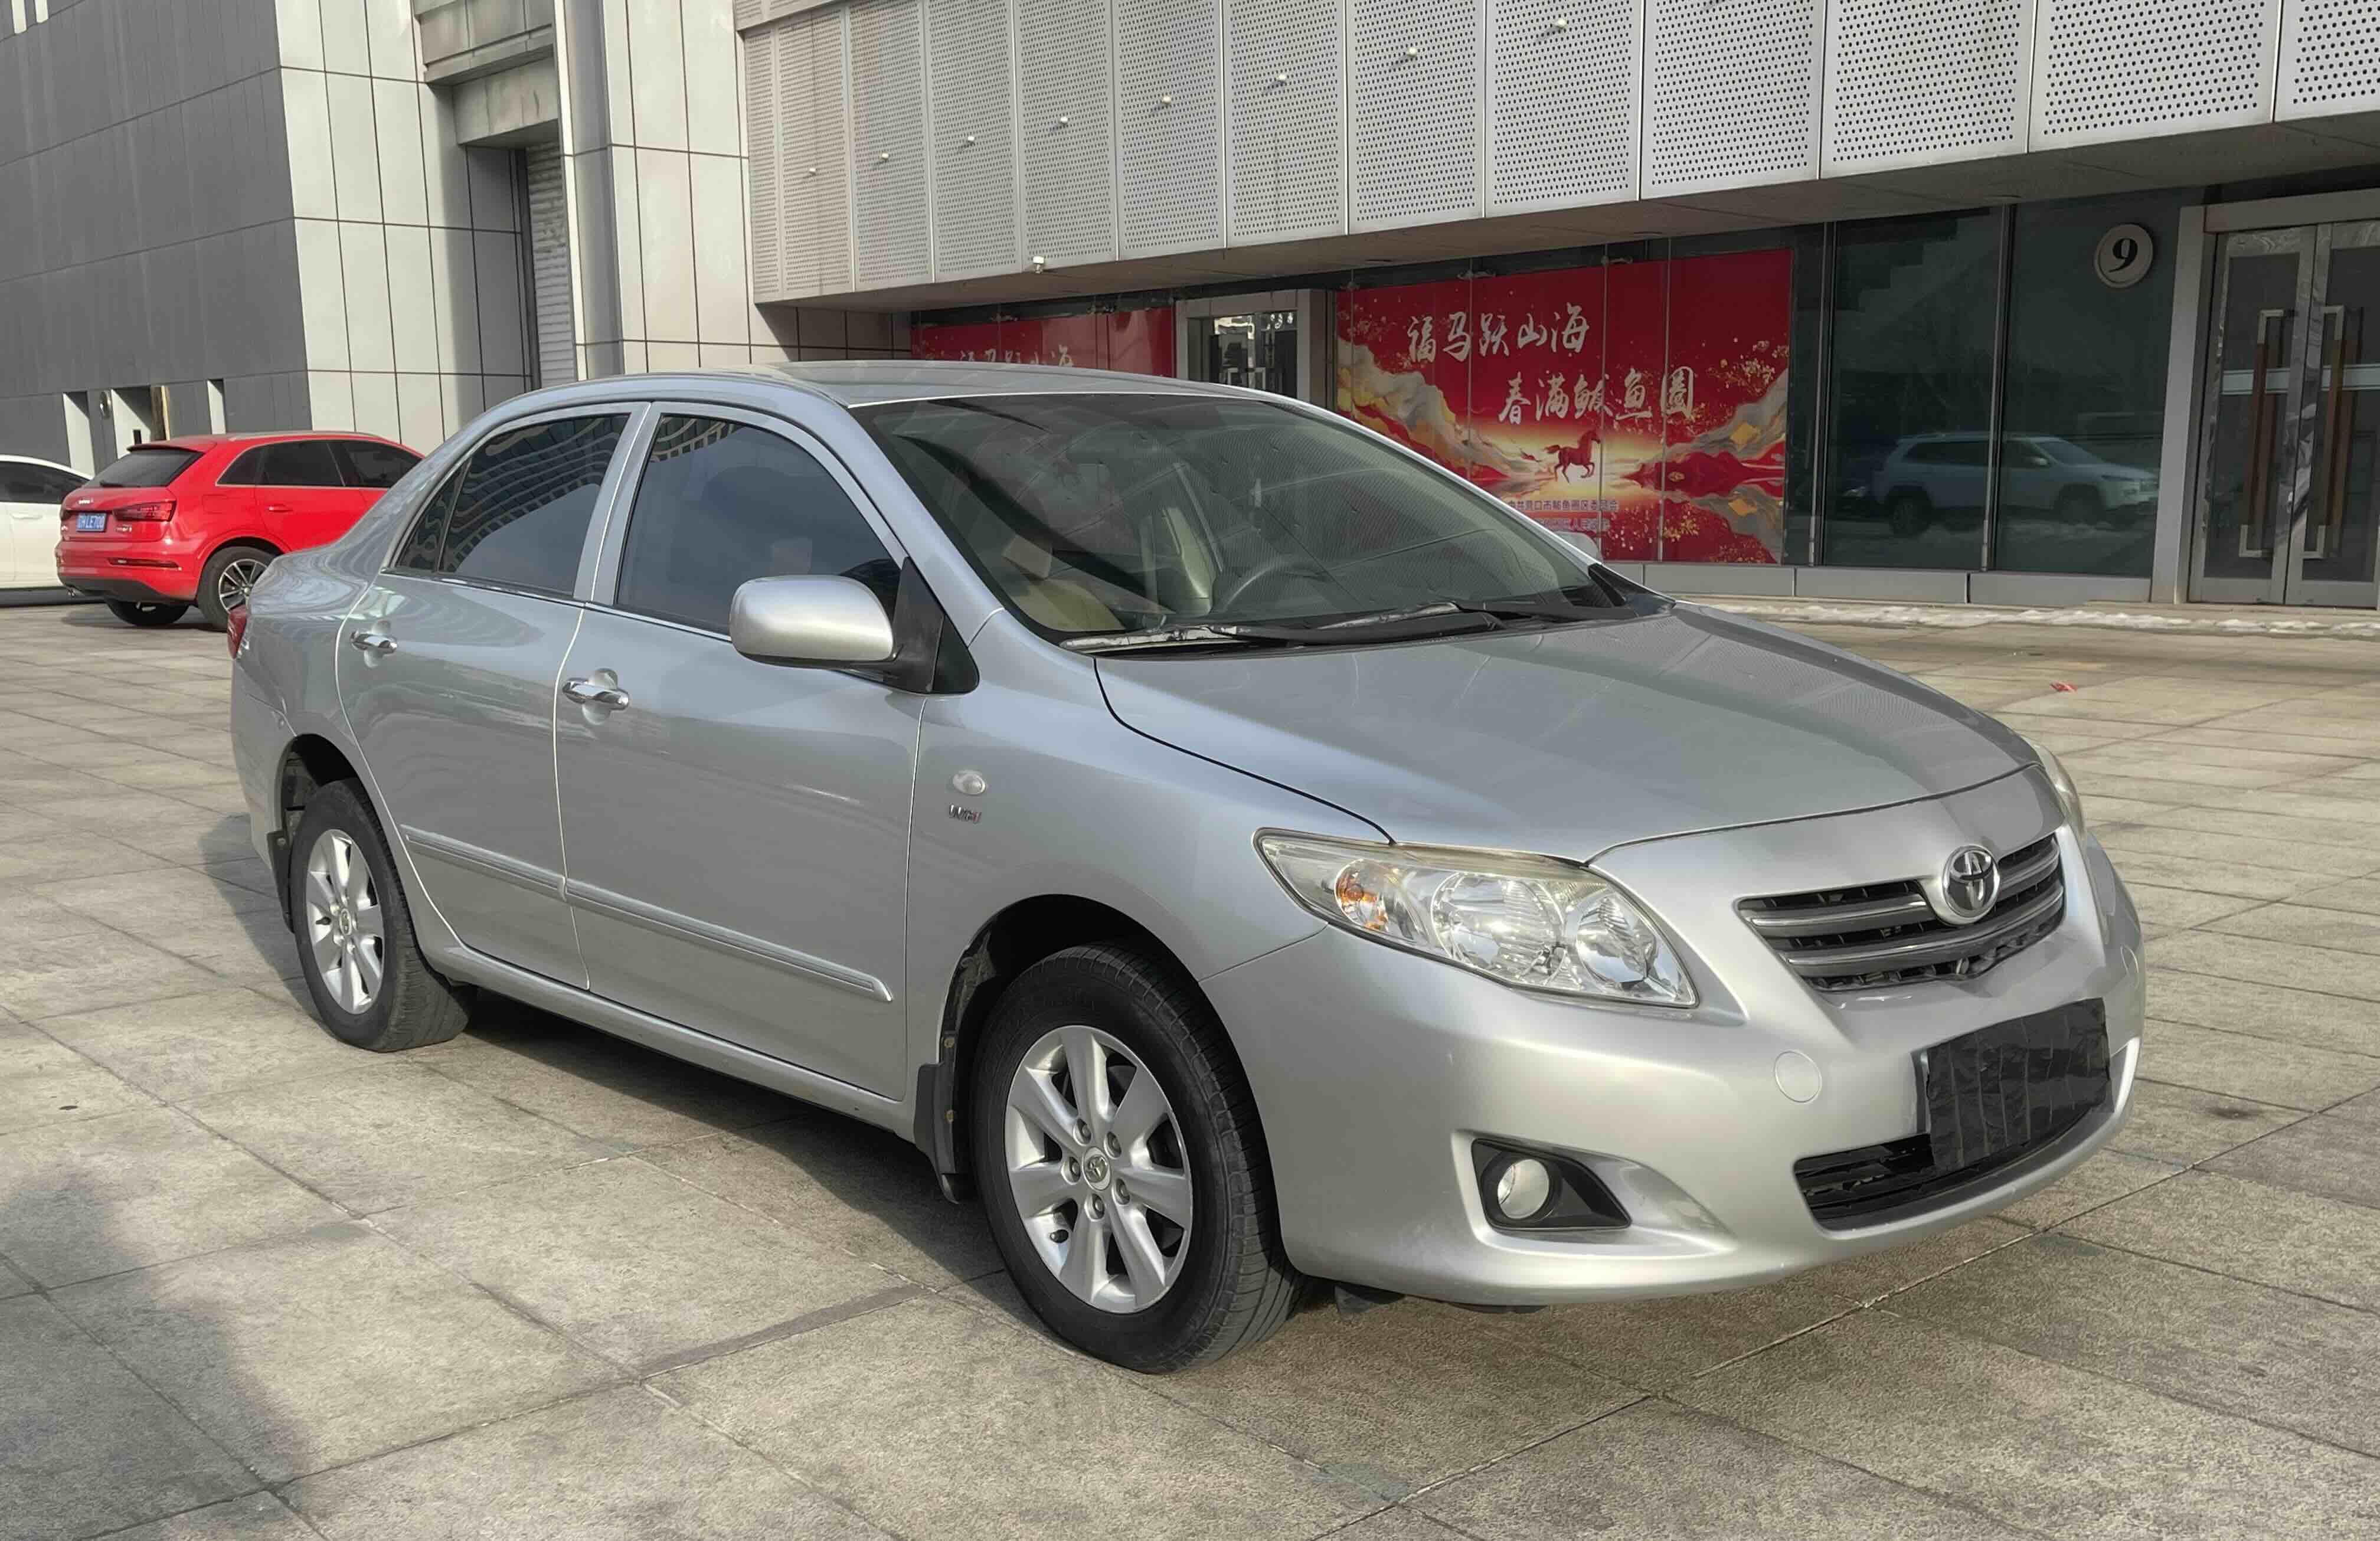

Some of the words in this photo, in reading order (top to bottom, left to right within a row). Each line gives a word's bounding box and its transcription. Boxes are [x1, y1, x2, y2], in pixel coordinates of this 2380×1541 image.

[2108, 237, 2138, 273] 9
[1407, 302, 1590, 362] 福马跃山海
